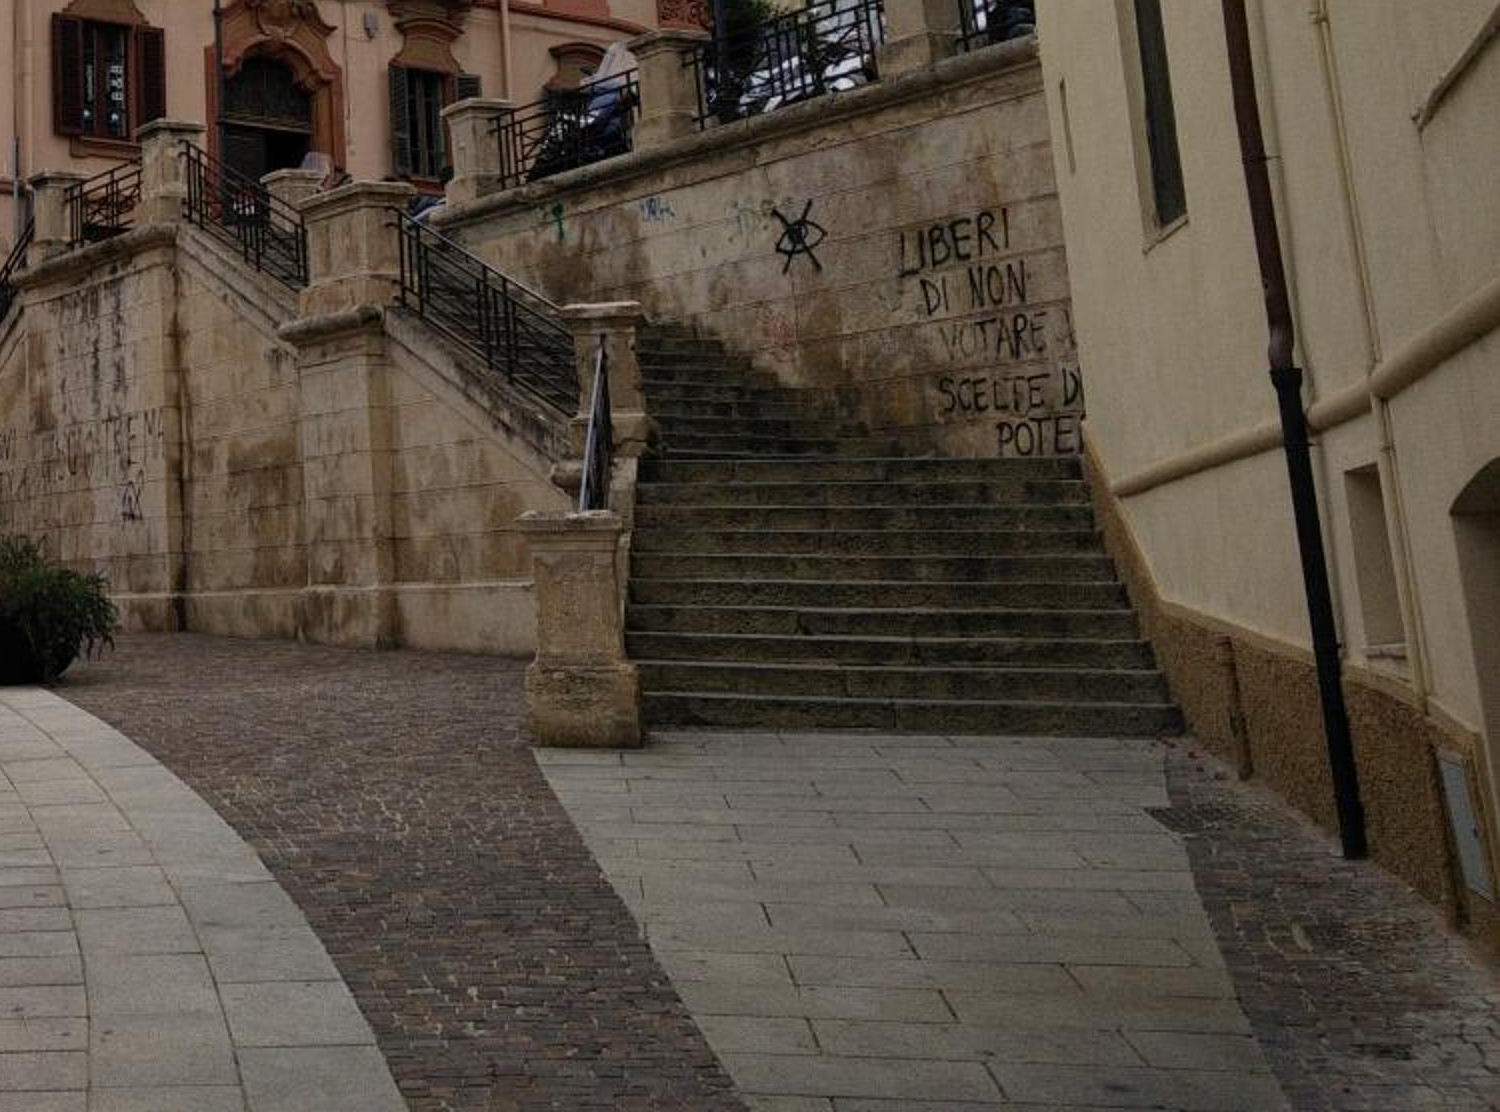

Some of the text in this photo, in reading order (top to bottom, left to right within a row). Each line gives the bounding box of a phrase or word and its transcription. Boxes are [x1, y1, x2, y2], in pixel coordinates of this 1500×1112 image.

[898, 207, 1010, 279] LIBERI
[919, 259, 1028, 316] DI NON
[939, 311, 1048, 361] VOTARE
[939, 373, 1051, 413] SCELTE
